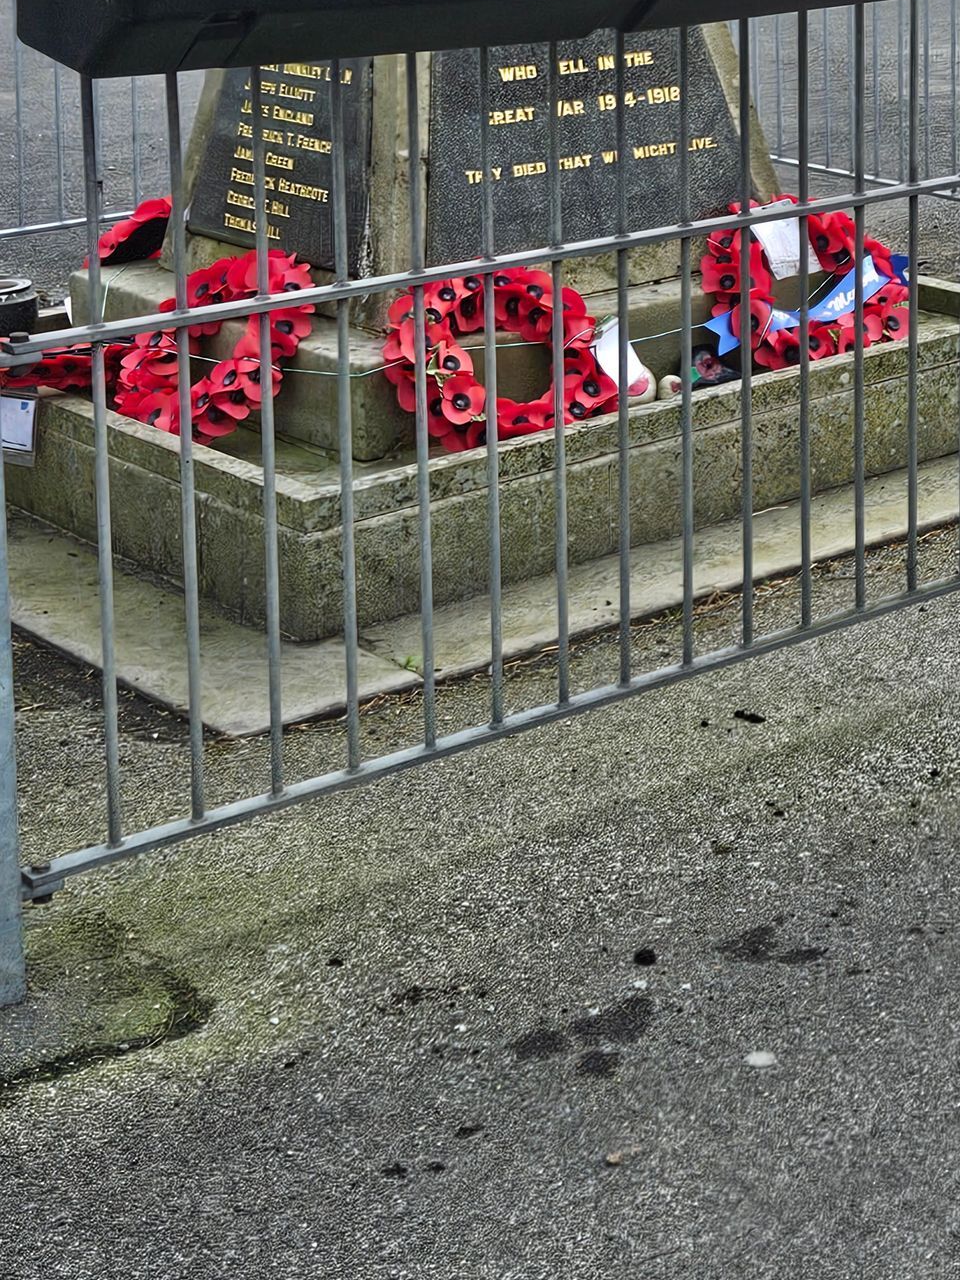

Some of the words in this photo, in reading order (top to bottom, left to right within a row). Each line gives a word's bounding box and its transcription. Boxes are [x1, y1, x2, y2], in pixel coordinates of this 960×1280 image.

[498, 65, 538, 82] WHO
[558, 59, 589, 75] ELL
[597, 55, 615, 71] IN
[623, 51, 654, 68] THE
[597, 86, 681, 111] 194-1918
[465, 167, 502, 184] THY
[513, 162, 547, 178] DIED
[601, 150, 619, 165] W
[633, 142, 677, 160] MIGHT
